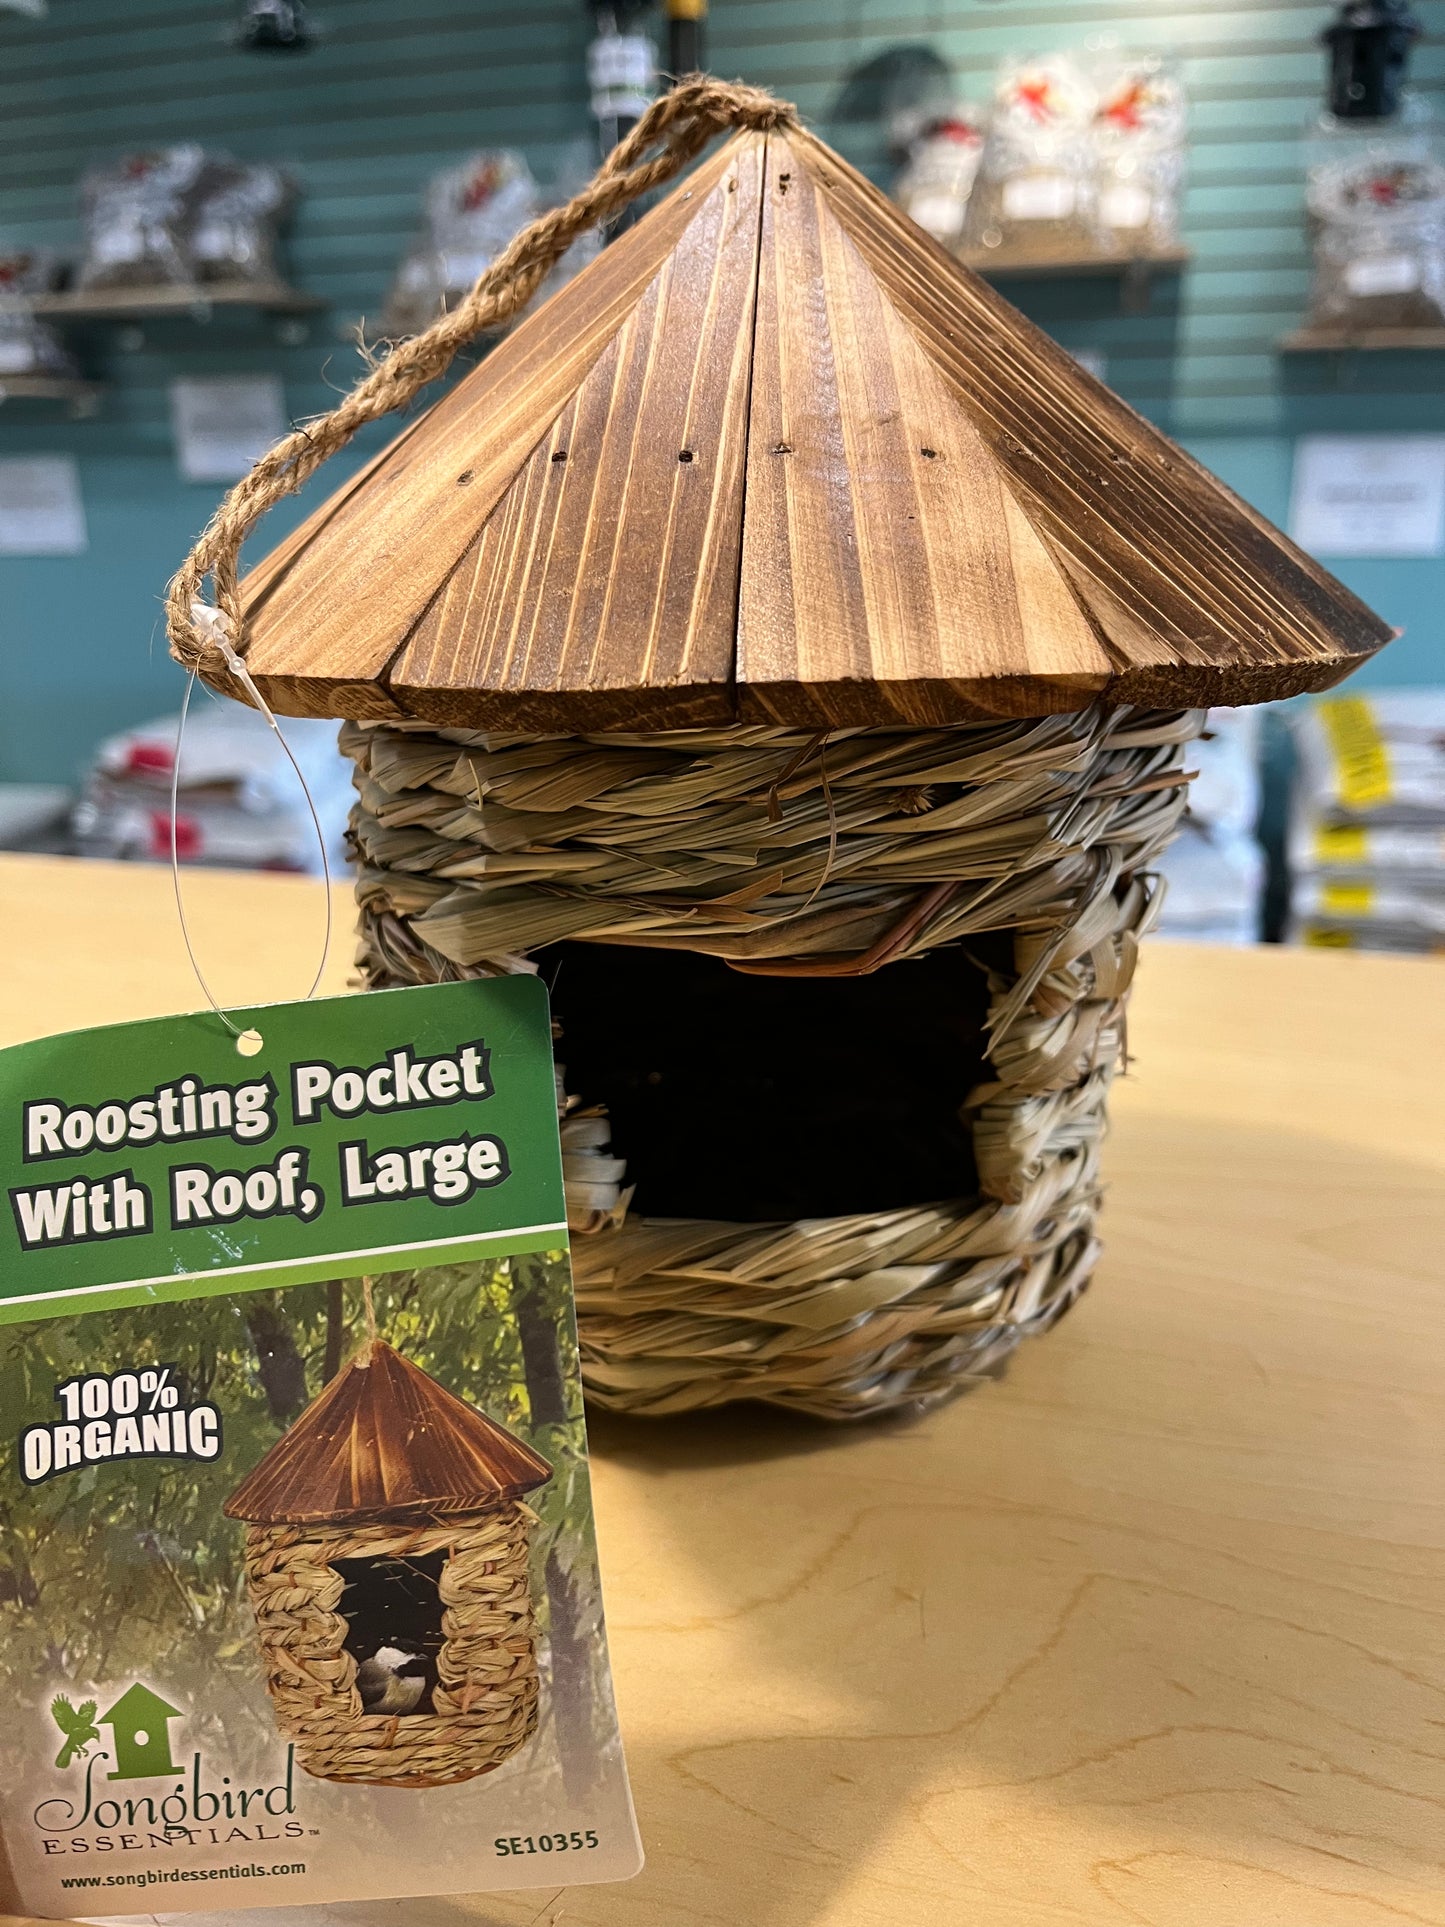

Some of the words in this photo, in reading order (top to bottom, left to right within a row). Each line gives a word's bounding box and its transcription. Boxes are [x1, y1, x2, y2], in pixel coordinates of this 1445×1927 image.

[27, 1079, 273, 1157] Roosting
[296, 1046, 488, 1118] Pocket
[15, 1176, 146, 1243] With
[174, 1151, 318, 1222] Roof,
[345, 1138, 502, 1200] Large
[59, 1368, 179, 1421] 100%
[23, 1406, 219, 1481] ORGANIC
[34, 1743, 297, 1839] Songbird
[61, 1862, 306, 1888] www.songbirdessentials.com
[494, 1830, 599, 1857] SE10355
